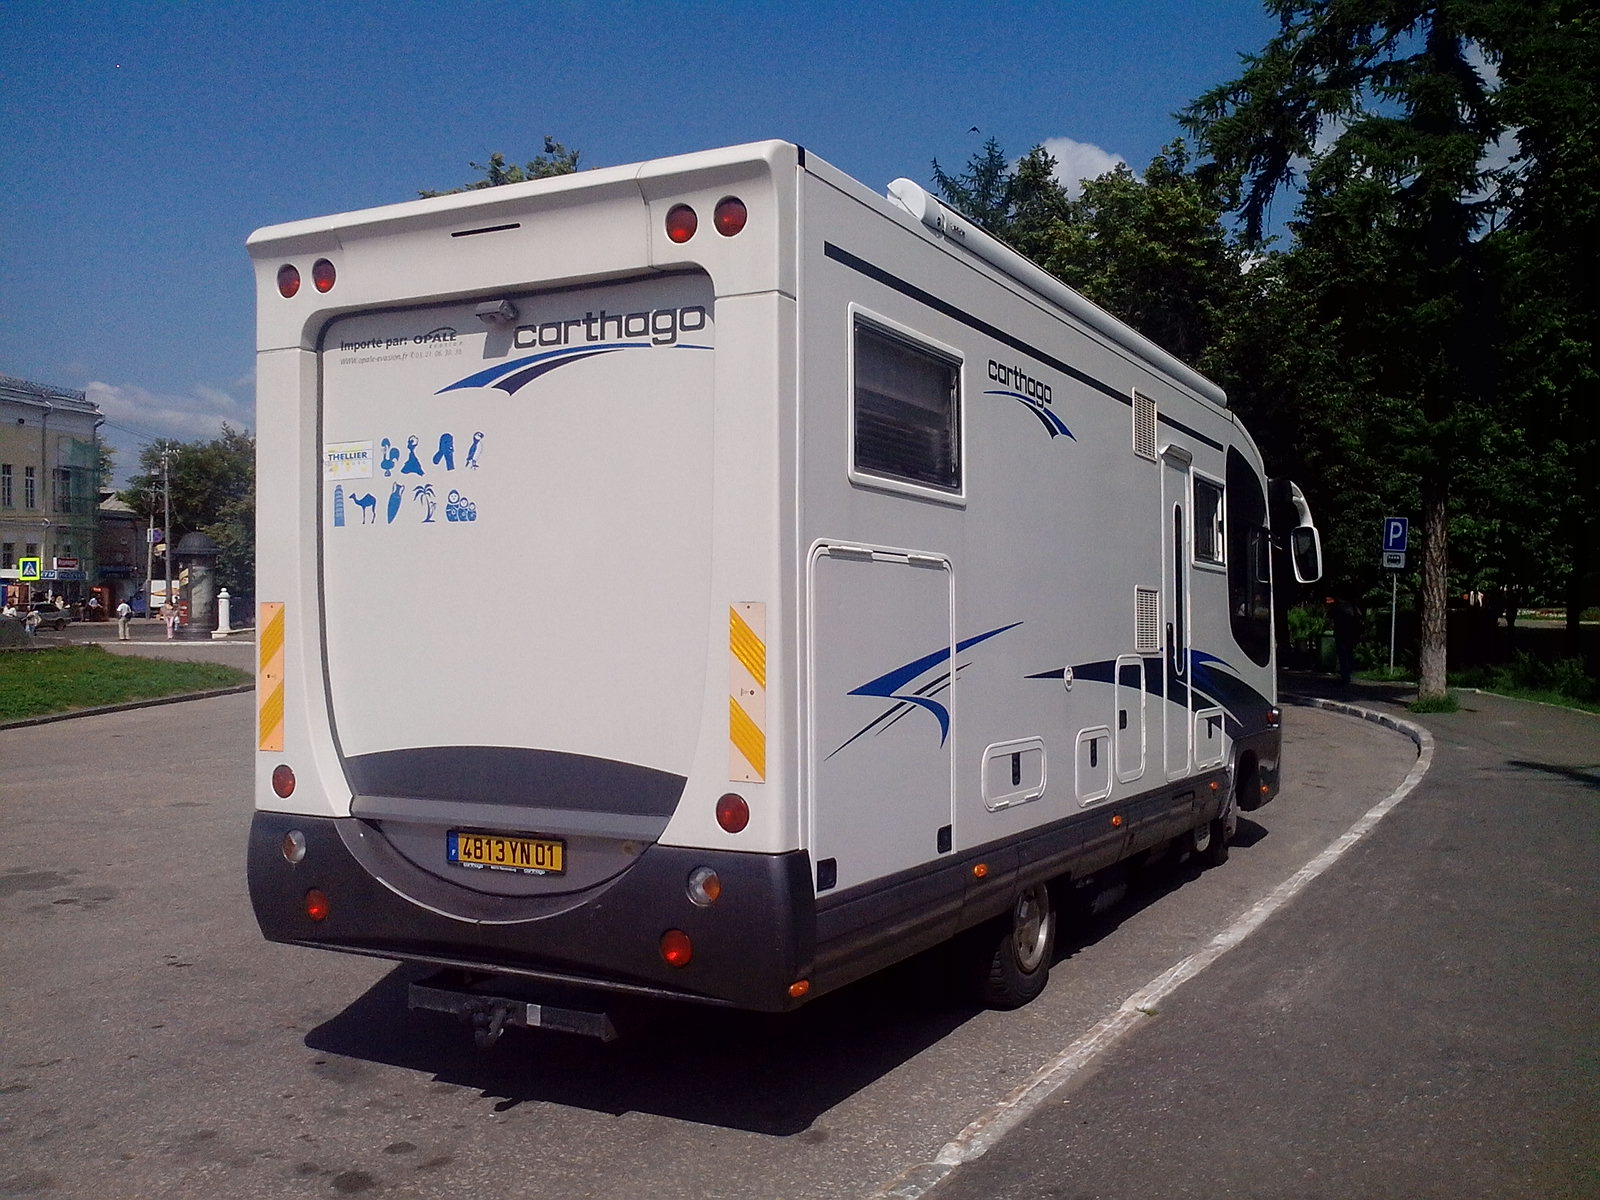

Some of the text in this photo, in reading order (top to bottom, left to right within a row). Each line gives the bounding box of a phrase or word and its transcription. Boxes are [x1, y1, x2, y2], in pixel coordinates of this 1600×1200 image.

[413, 333, 457, 345] OPALE
[514, 306, 706, 349] carthago
[988, 359, 1052, 409] carthago
[328, 451, 368, 461] THELLIER
[1388, 521, 1403, 547] P
[463, 836, 505, 862] 4813
[508, 841, 531, 865] YN
[535, 843, 554, 867] 01
